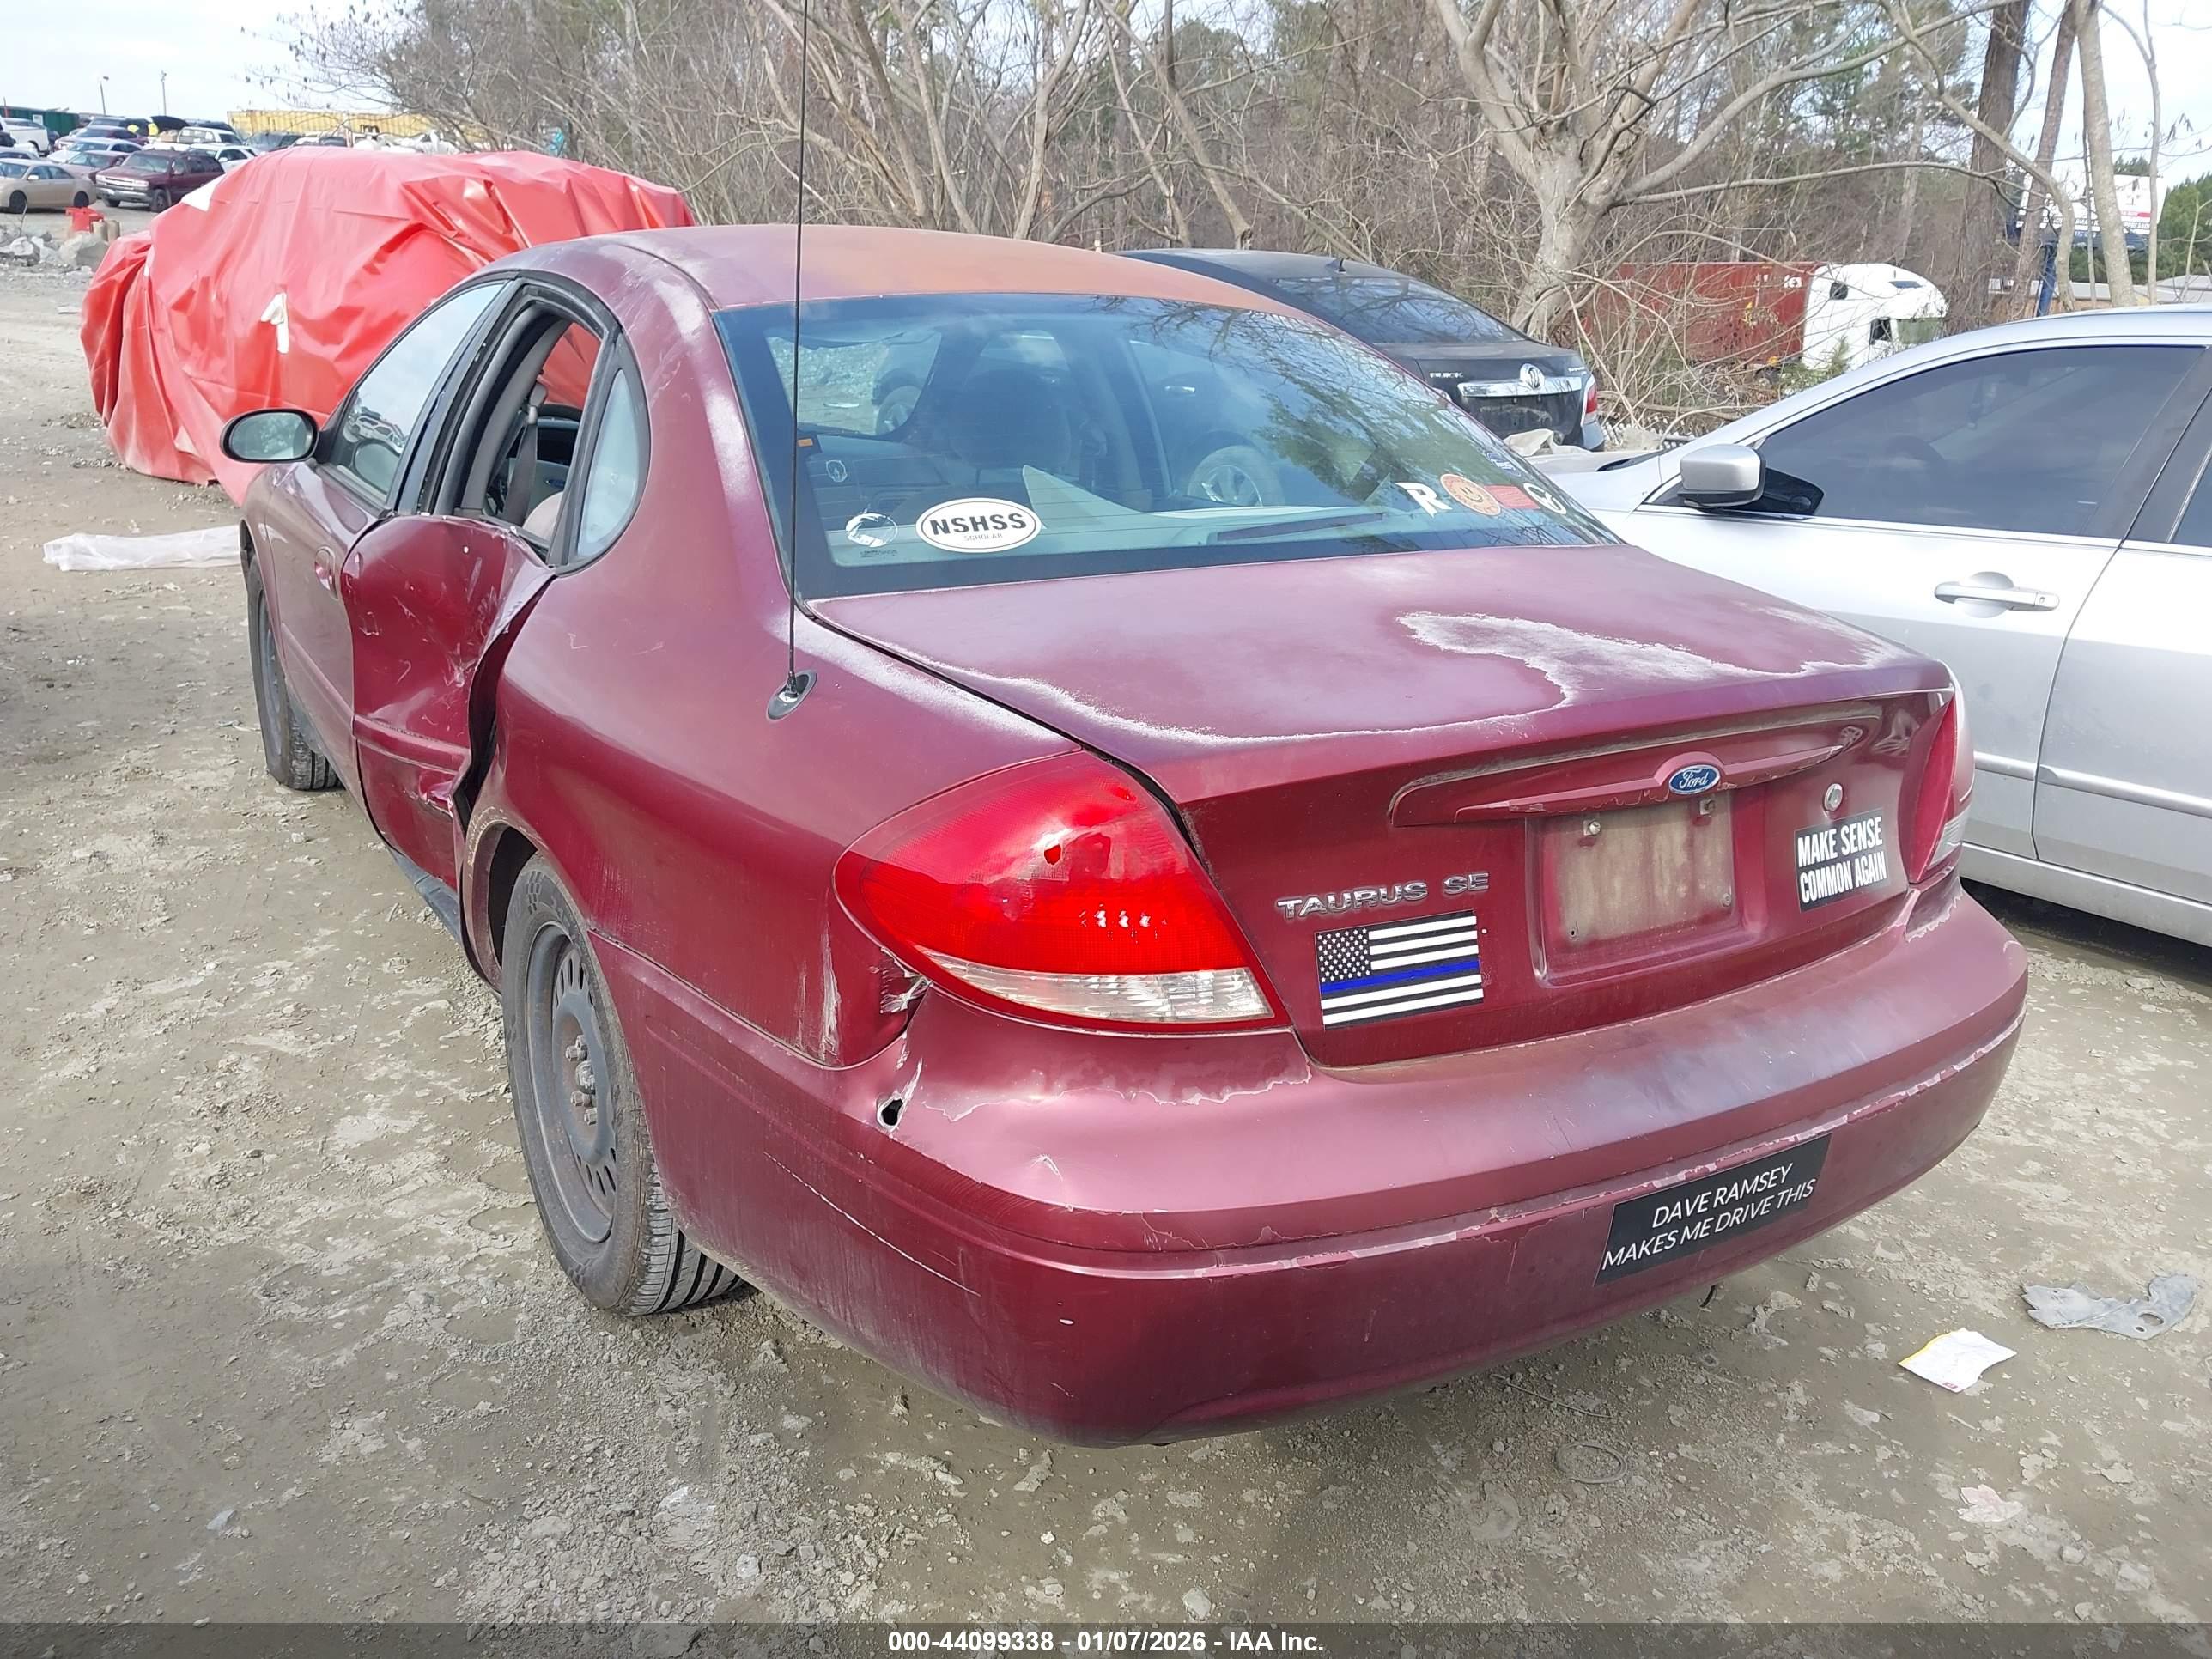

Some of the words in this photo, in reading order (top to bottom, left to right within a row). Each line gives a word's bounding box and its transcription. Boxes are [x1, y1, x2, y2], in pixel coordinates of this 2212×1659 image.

[929, 513, 1027, 535] NSHSS
[1679, 769, 1710, 789] Ford
[1797, 828, 1838, 868] MAKE
[1840, 817, 1883, 856] SENSE
[1277, 882, 1427, 919] TAURUS
[1443, 872, 1490, 896] SE
[1800, 860, 1854, 903] COMMON
[1855, 851, 1887, 888] AGAIN
[1652, 1191, 1712, 1229] DAVE
[1712, 1162, 1794, 1209] RAMSEY
[1601, 1229, 1680, 1271] MAKES
[1680, 1217, 1715, 1245] ME
[1715, 1194, 1776, 1233] DRIVE
[1777, 1178, 1817, 1210] THIS
